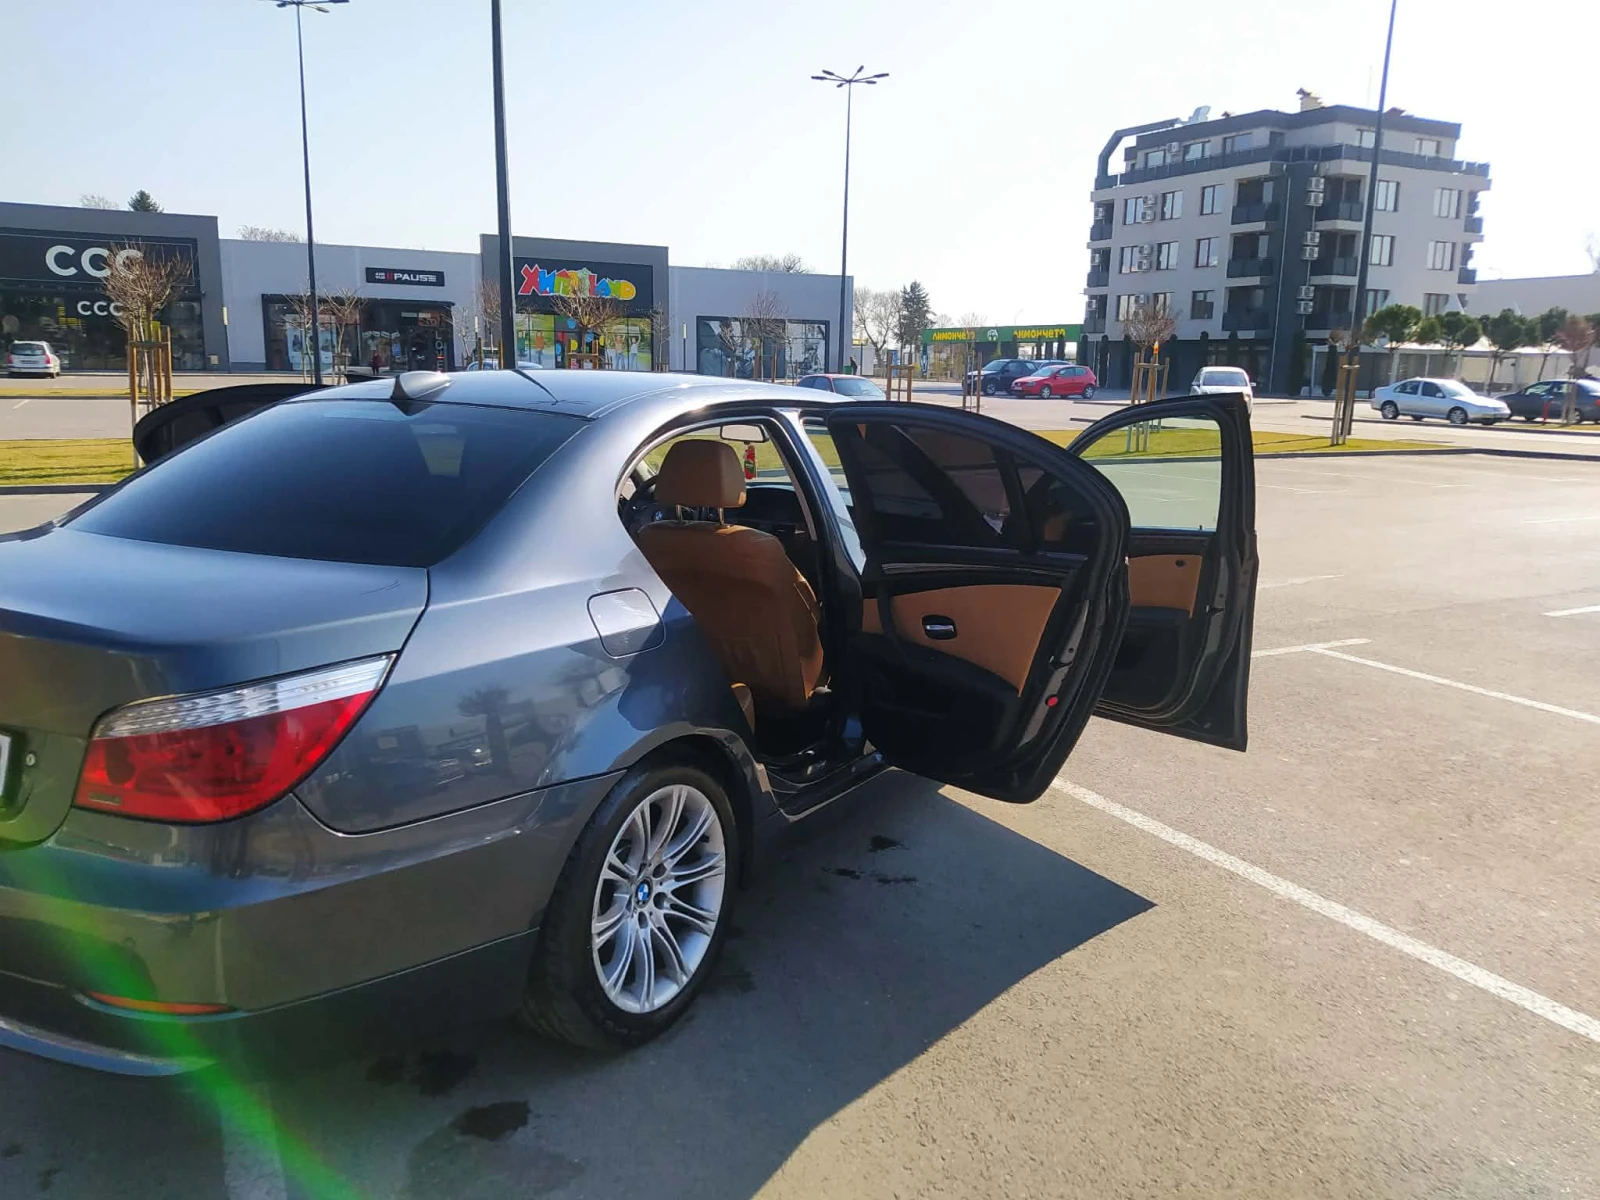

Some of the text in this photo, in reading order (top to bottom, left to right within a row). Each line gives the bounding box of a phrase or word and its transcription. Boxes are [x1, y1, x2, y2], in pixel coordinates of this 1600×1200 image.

[45, 245, 144, 279] CCC
[393, 273, 437, 282] PAUSE
[77, 301, 124, 316] CCC
